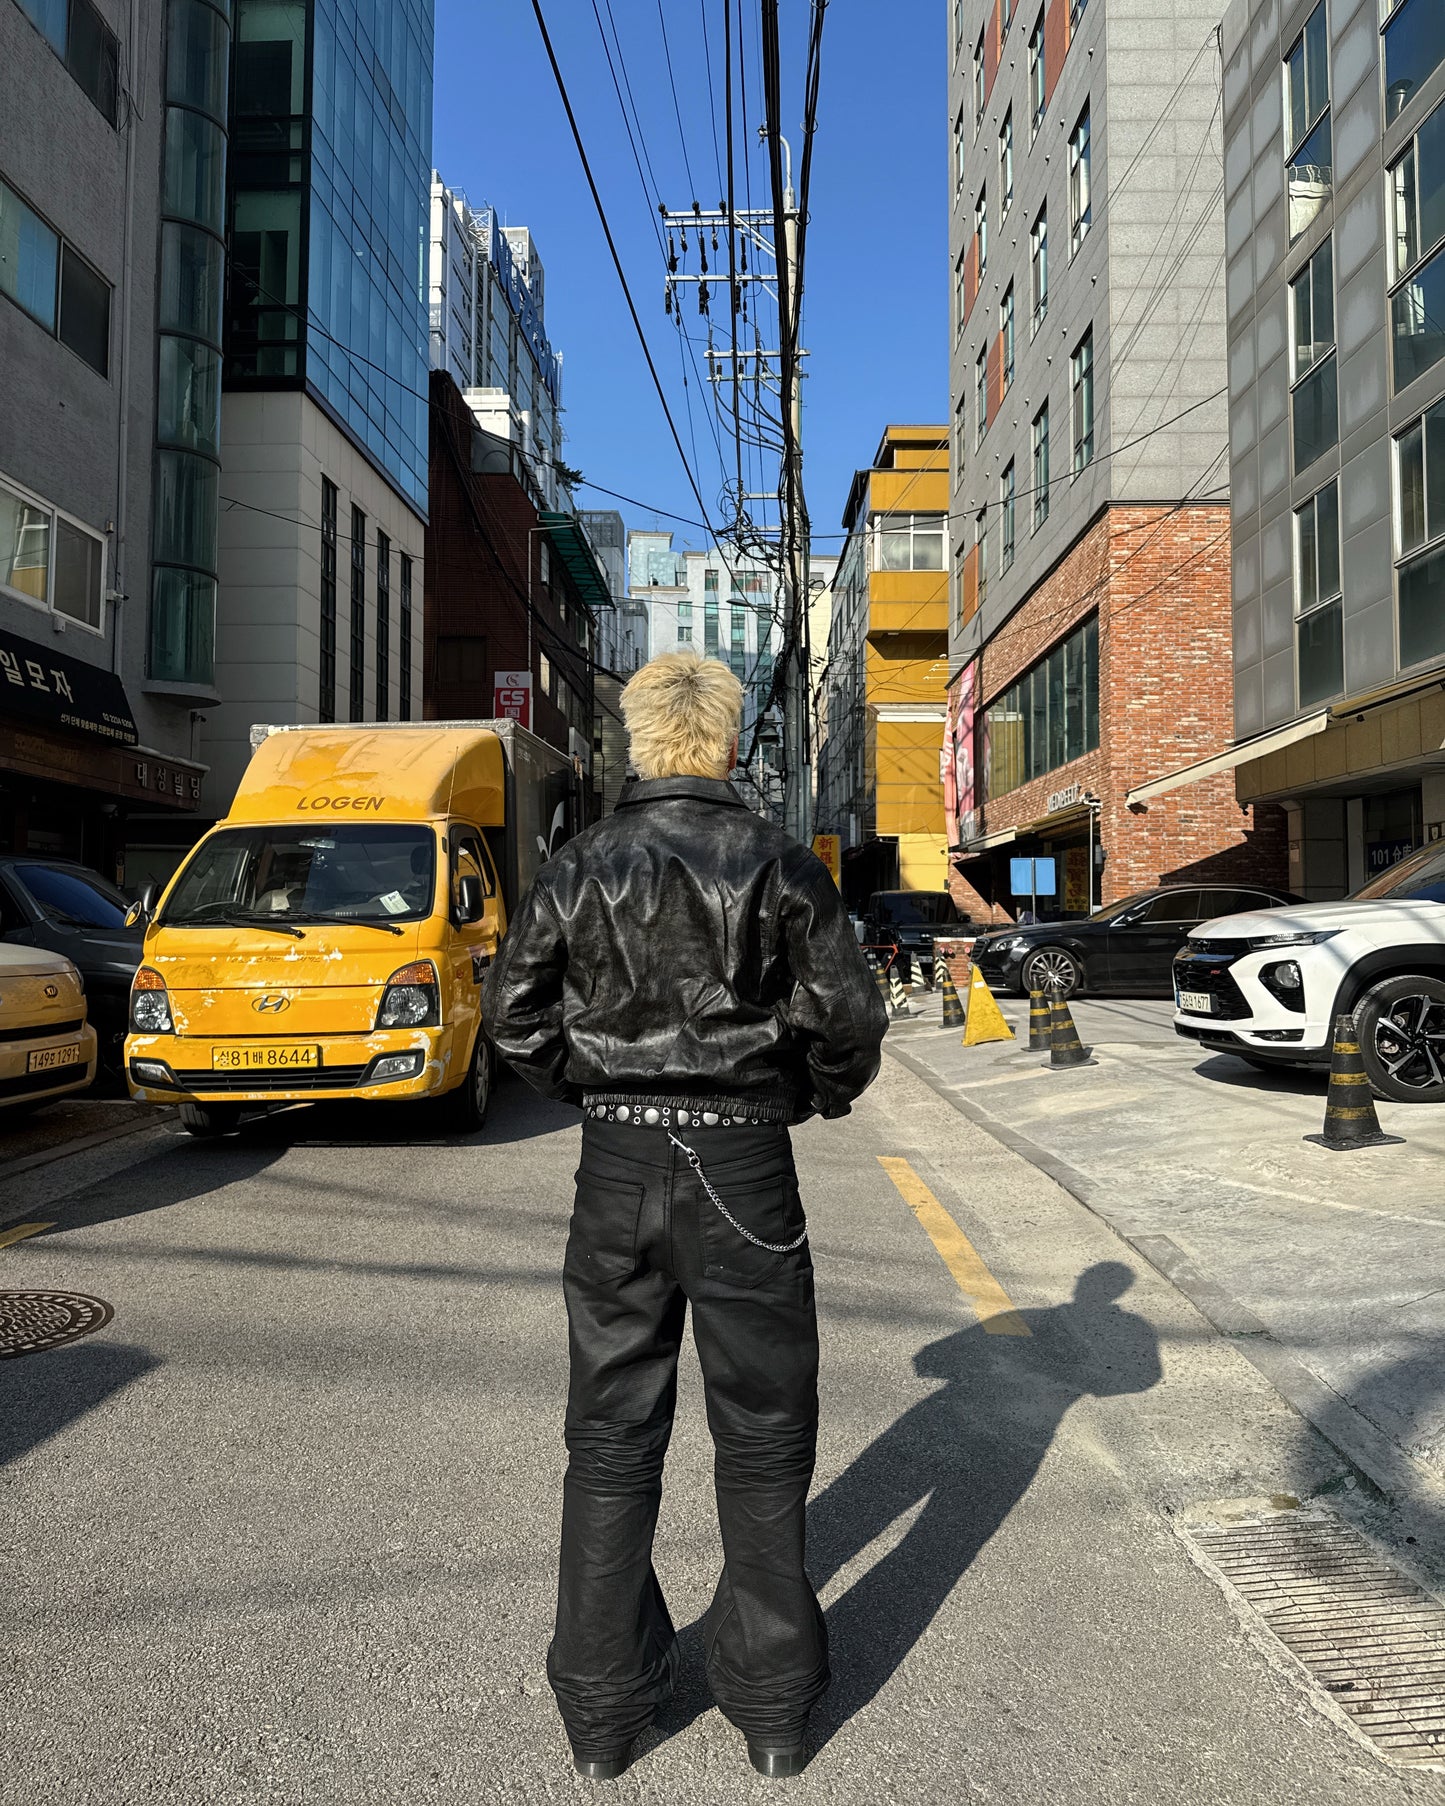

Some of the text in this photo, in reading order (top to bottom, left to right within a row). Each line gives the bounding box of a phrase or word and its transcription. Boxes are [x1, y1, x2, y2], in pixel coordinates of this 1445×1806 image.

[0, 649, 74, 703] 일모자
[500, 690, 525, 706] CS
[137, 762, 200, 799] 대성빌딩
[296, 796, 386, 811] LOGEN
[1371, 848, 1389, 865] 101
